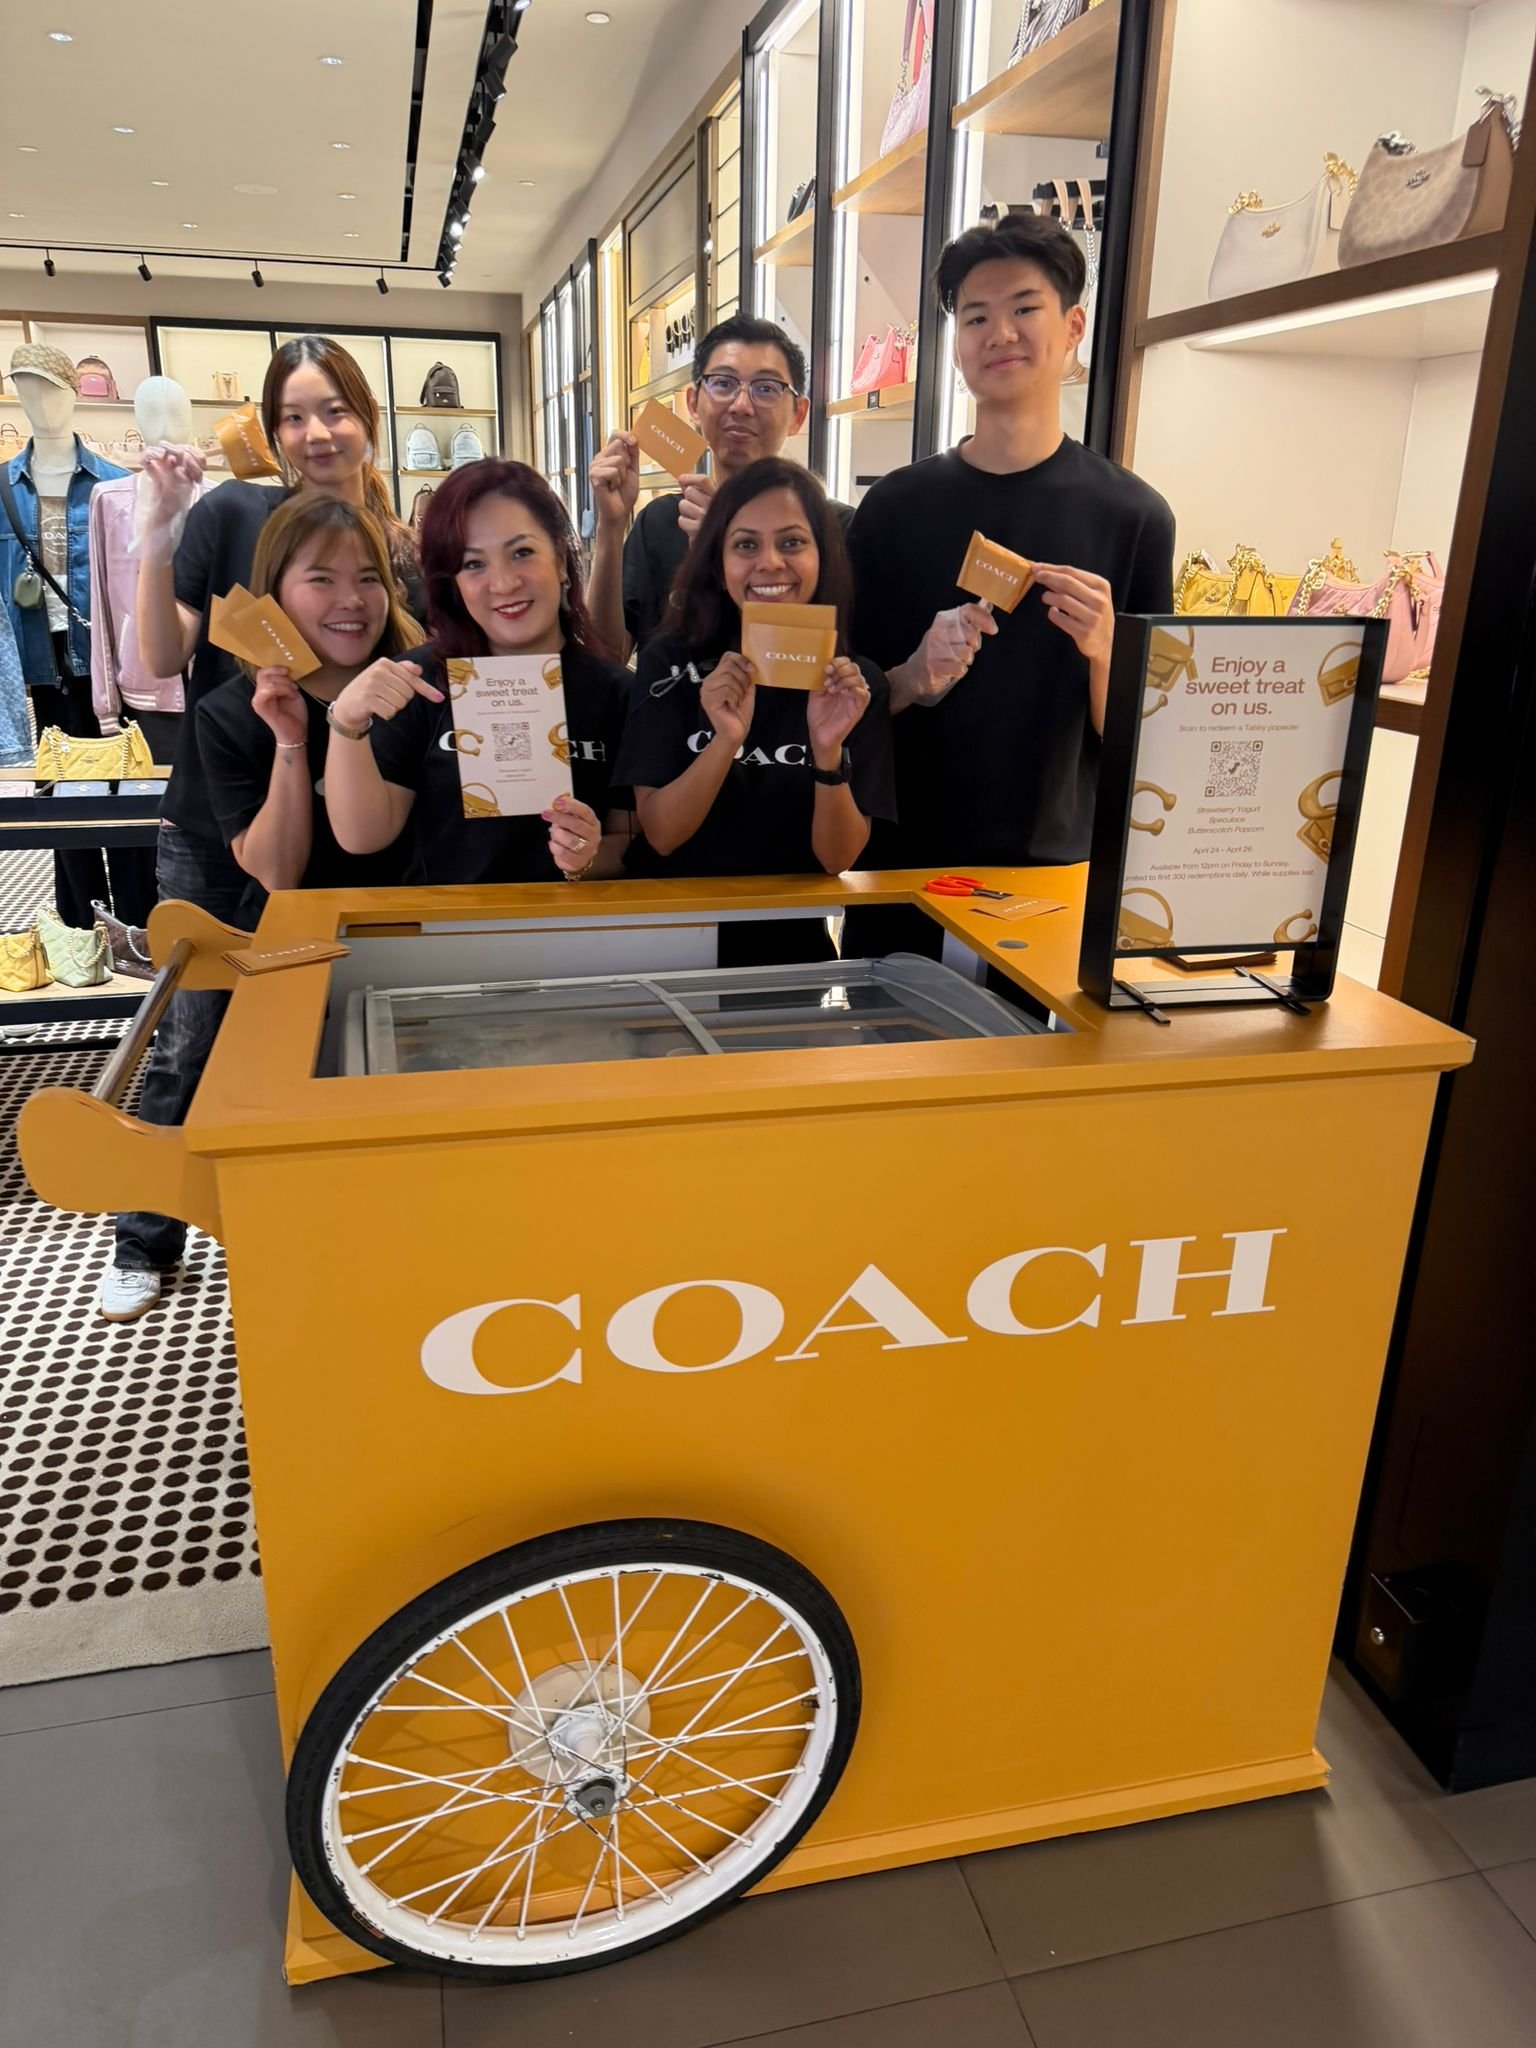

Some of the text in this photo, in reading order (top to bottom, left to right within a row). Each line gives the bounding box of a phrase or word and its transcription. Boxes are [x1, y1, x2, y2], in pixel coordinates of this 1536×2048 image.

[650, 424, 685, 454] COACH
[976, 559, 1018, 585] COACH
[261, 619, 294, 661] COACH
[765, 651, 816, 664] COACH
[1211, 656, 1286, 676] Enjoy a
[485, 678, 526, 688] Enjoy a
[1185, 678, 1306, 695] sweet treat
[475, 687, 539, 698] sweet treat
[491, 699, 525, 708] on us.
[1211, 702, 1272, 715] on us.
[1178, 724, 1198, 732] Scan
[1199, 724, 1207, 732] to
[1208, 723, 1237, 732] redeem
[1237, 806, 1261, 814] Yogurt
[1226, 845, 1241, 853] April
[1182, 863, 1200, 871] from
[1201, 862, 1219, 870] 12pm
[1231, 861, 1253, 869] Friday
[1254, 860, 1261, 868] to
[1158, 873, 1171, 881] first
[420, 1227, 1288, 1395] COACH
